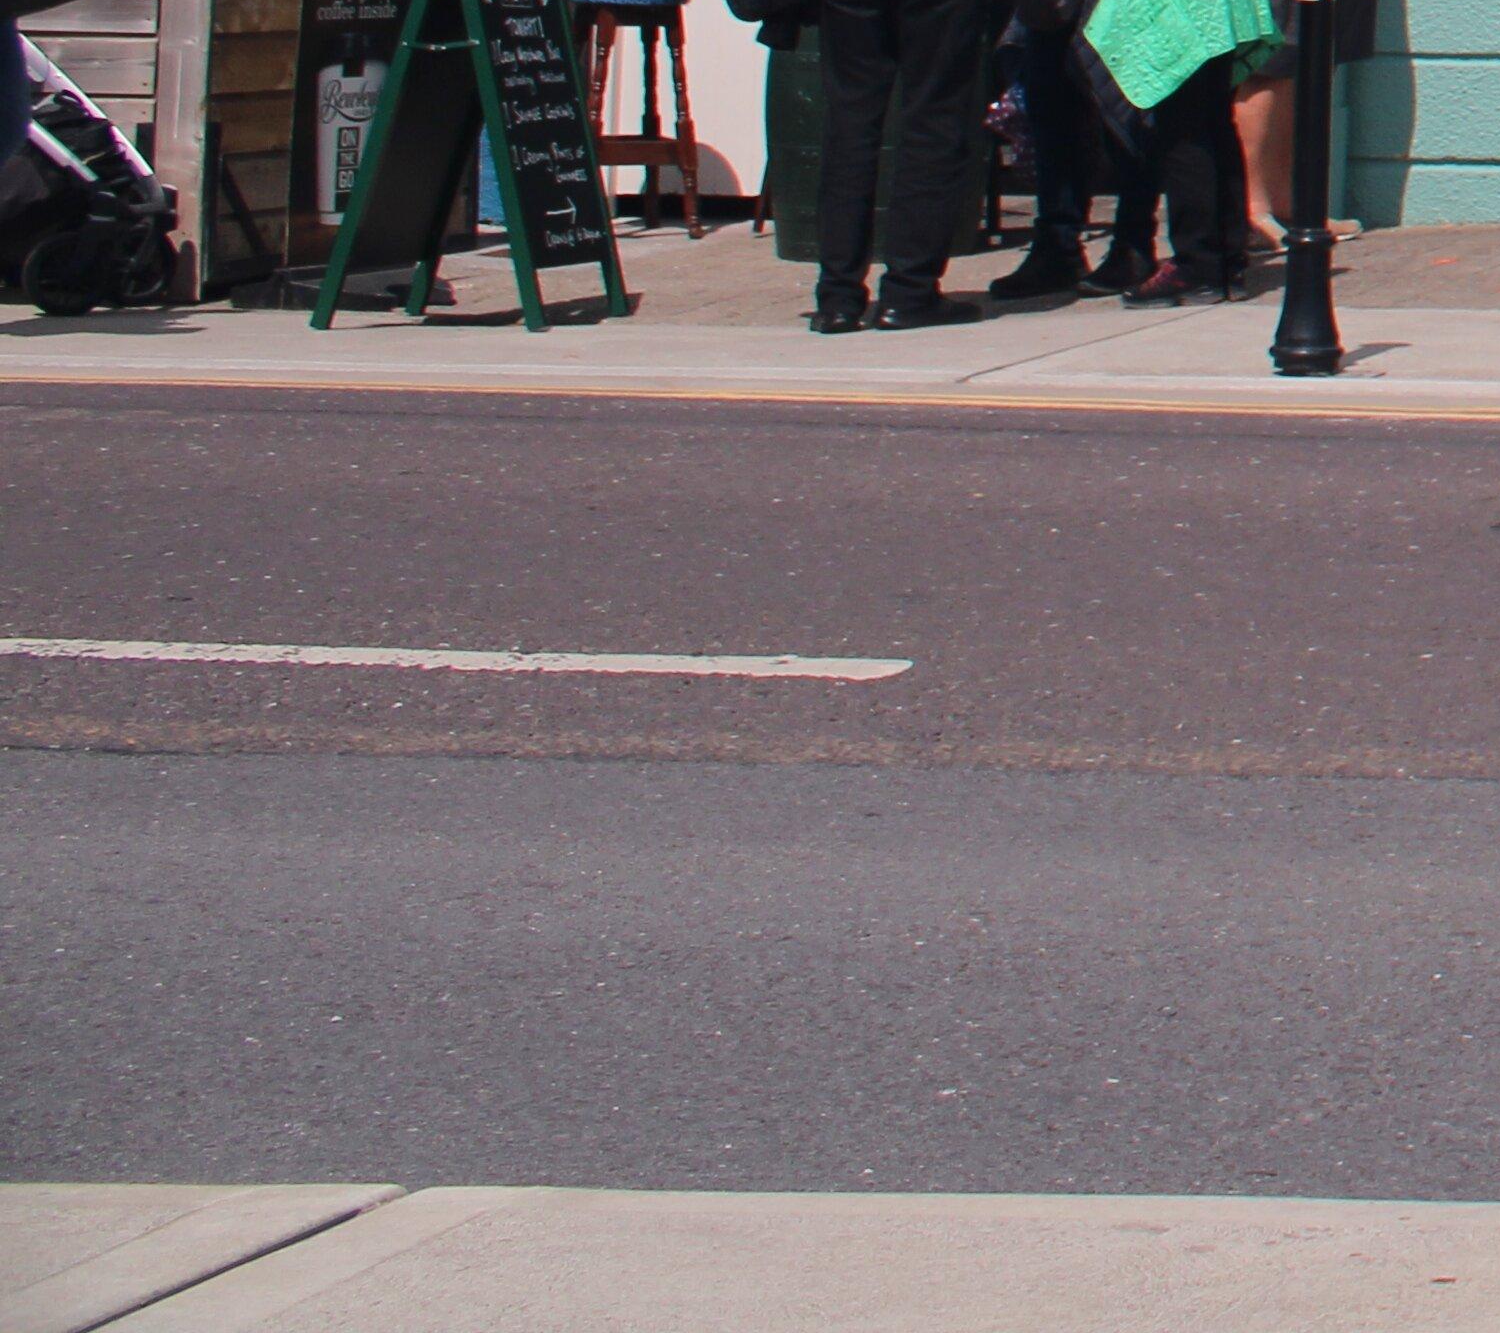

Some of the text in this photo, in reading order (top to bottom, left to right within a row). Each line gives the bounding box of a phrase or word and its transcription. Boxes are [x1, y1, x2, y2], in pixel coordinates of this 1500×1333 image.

[317, 0, 398, 21] coffee inside
[340, 128, 357, 147] ON
[337, 169, 355, 190] GO
